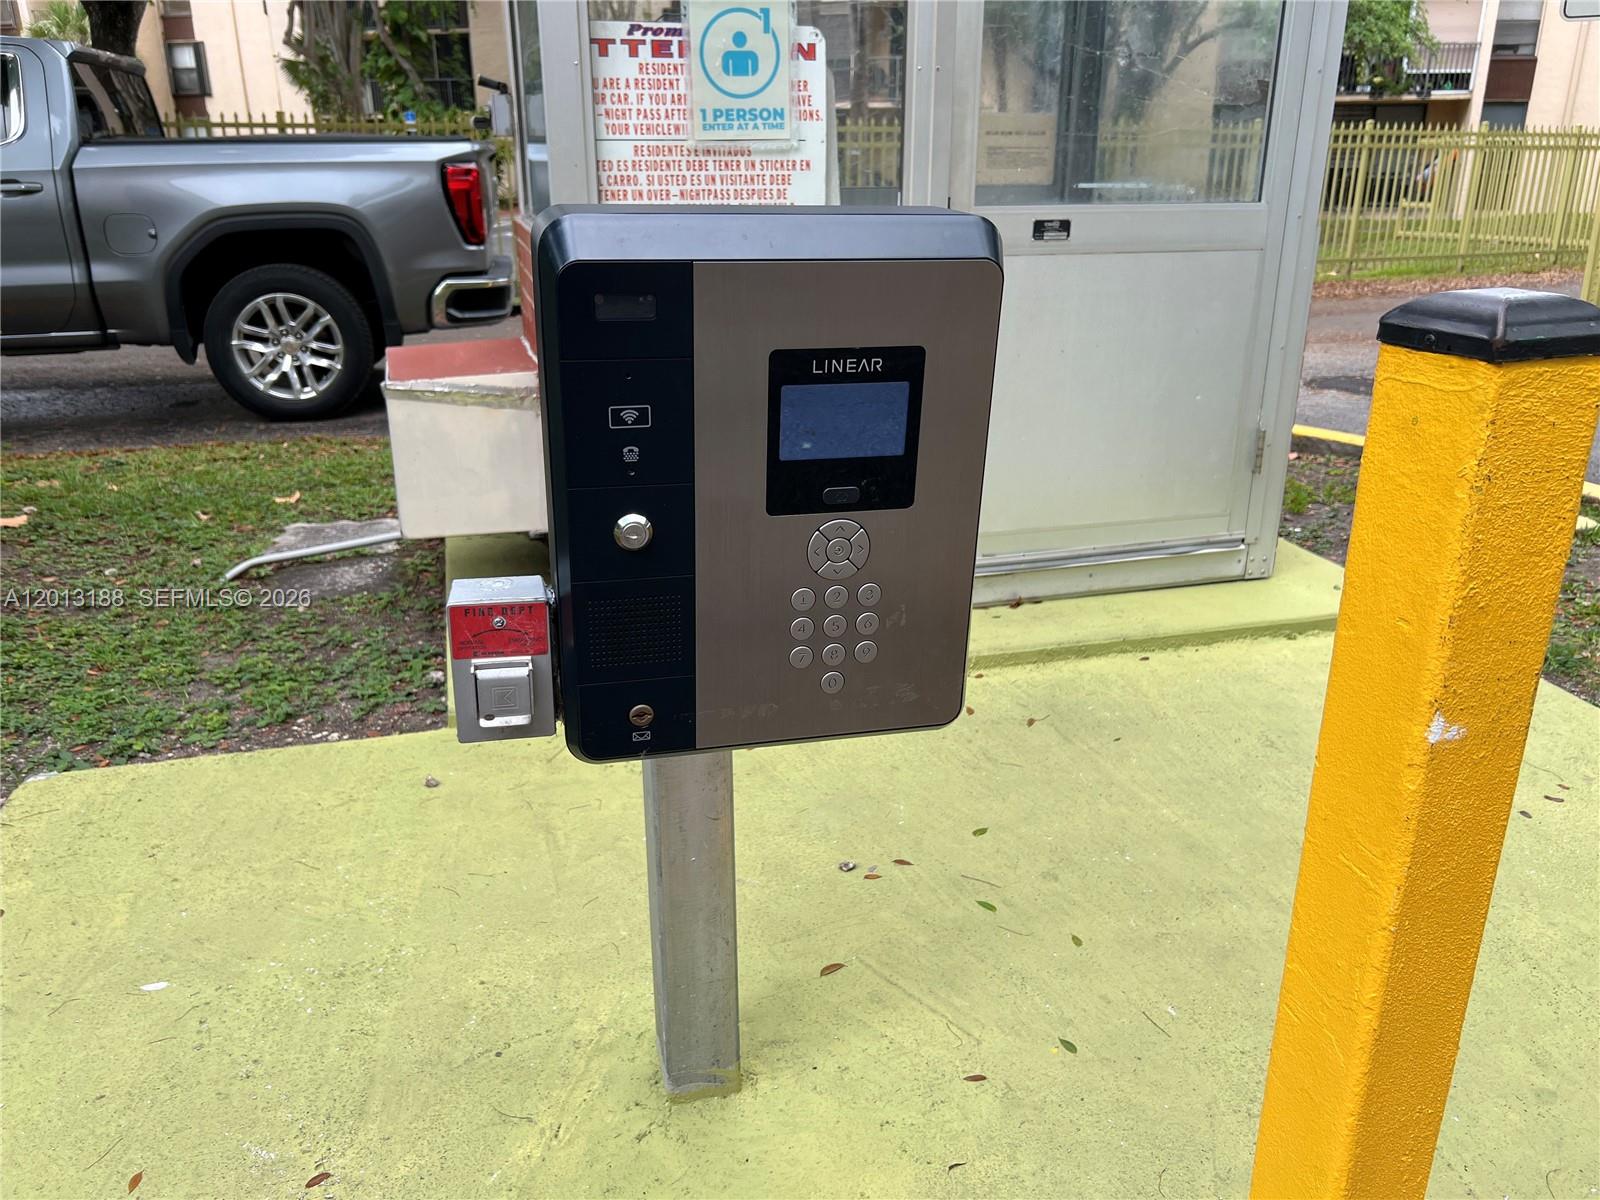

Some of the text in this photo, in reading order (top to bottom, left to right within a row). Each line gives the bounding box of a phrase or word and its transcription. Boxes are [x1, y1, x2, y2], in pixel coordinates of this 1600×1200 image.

[602, 78, 621, 90] ARE
[625, 78, 631, 90] A
[634, 78, 680, 90] RESIDENT
[610, 93, 633, 105] CAR.
[636, 93, 644, 105] IF
[649, 93, 667, 105] YOU
[637, 108, 662, 120] PASS
[699, 108, 785, 121] 1 PERSON
[605, 123, 630, 135] YOUR
[702, 123, 735, 131] ENTER
[762, 122, 785, 130] TIME
[617, 160, 629, 171] ES
[632, 160, 683, 171] RESIDENTE
[686, 160, 710, 171] DEBE
[712, 160, 741, 171] TENER
[744, 160, 756, 171] UN
[760, 160, 797, 171] STICKER
[800, 160, 811, 171] EN
[606, 174, 642, 186] CARRO.
[646, 174, 655, 186] SI
[657, 174, 687, 186] USTED
[690, 174, 702, 186] ES
[704, 174, 716, 186] UN
[719, 174, 766, 185] VISITANTE
[769, 174, 792, 185] DEBE
[631, 189, 644, 201] UN
[733, 188, 774, 200] DESPUES
[777, 188, 788, 200] DE
[812, 358, 883, 374] LINEAR
